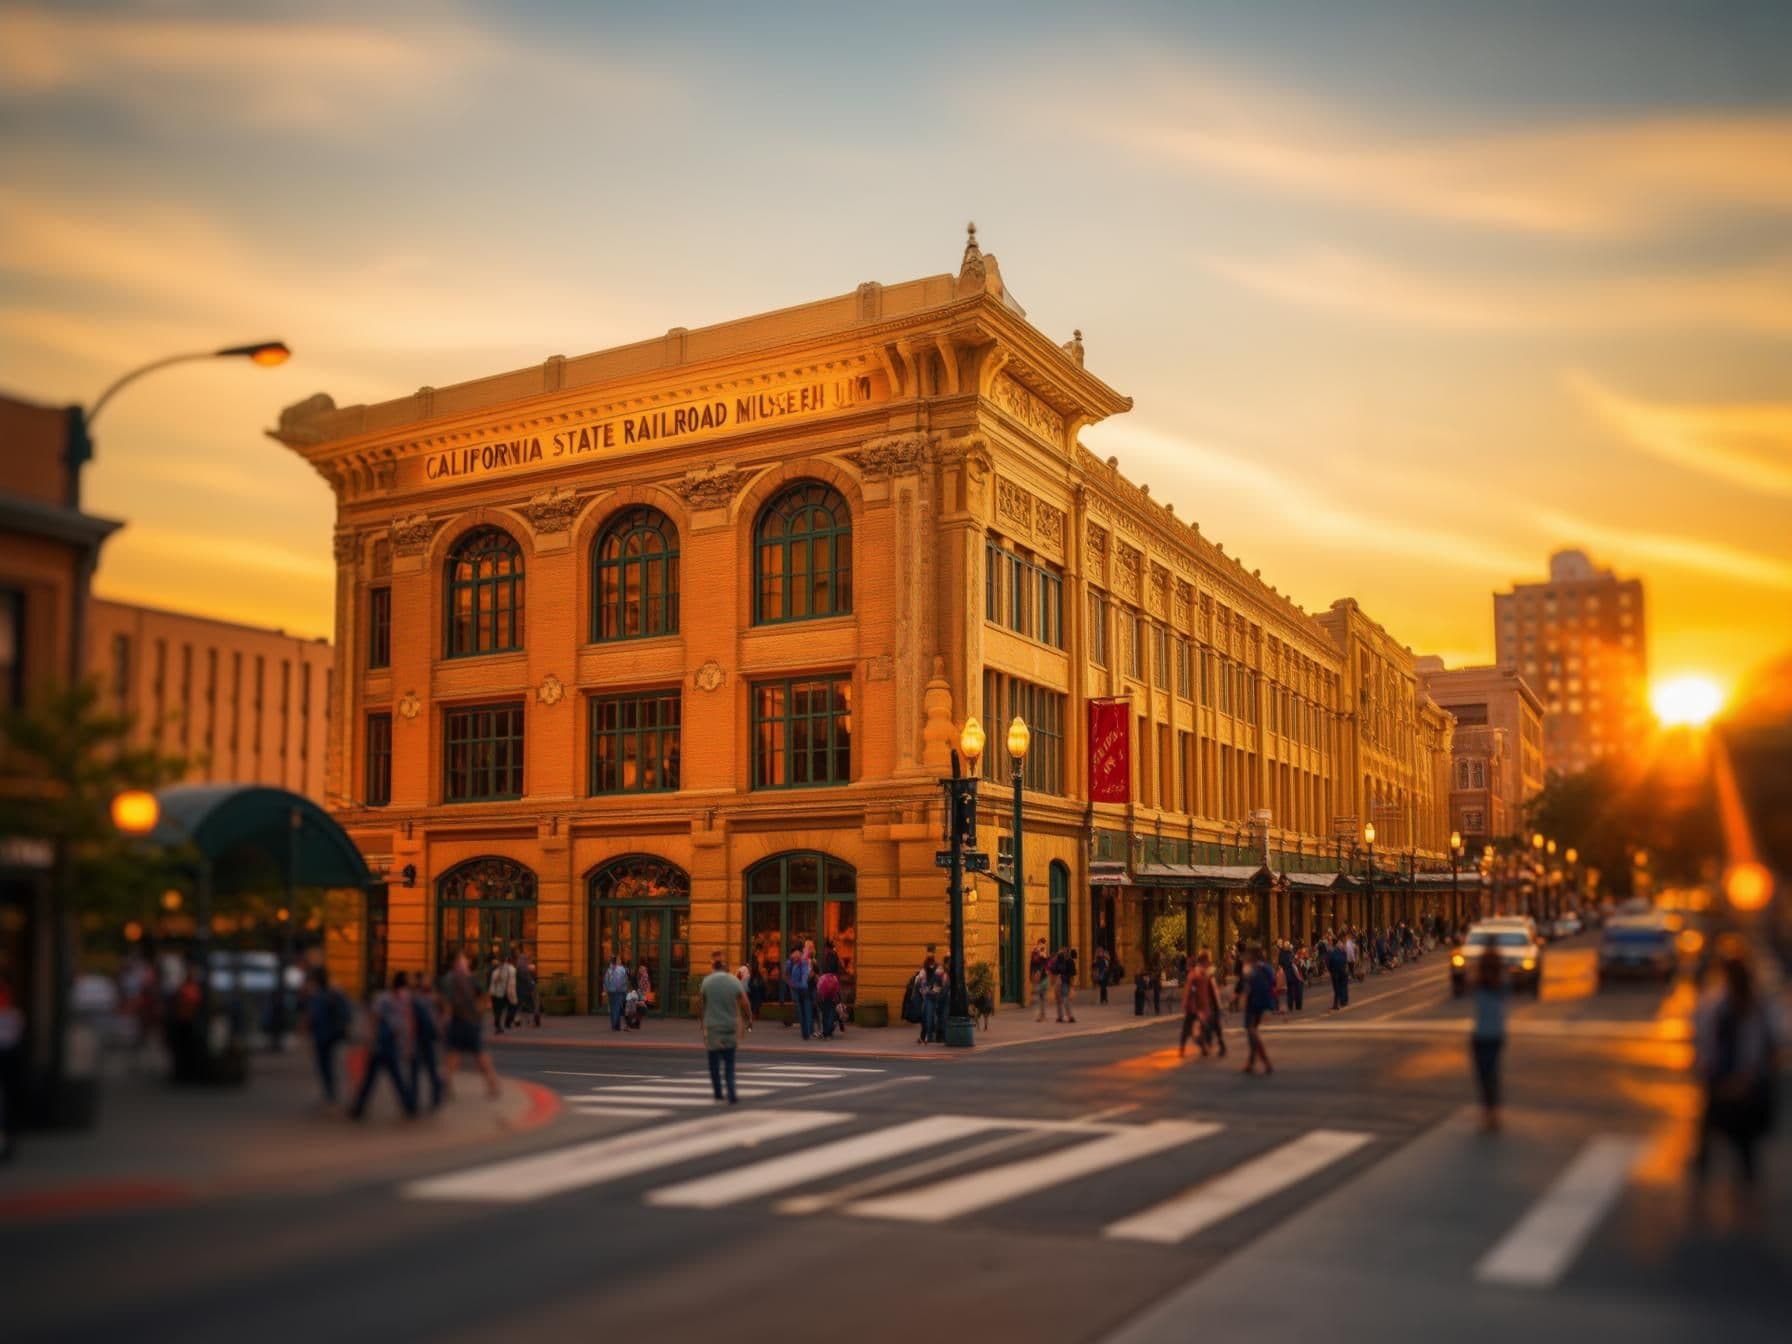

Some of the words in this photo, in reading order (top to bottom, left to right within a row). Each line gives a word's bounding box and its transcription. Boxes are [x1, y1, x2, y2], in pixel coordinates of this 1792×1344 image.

[426, 438, 542, 480] CALIFORNIA
[553, 421, 615, 457] STATE
[624, 403, 727, 444] RAILROAD
